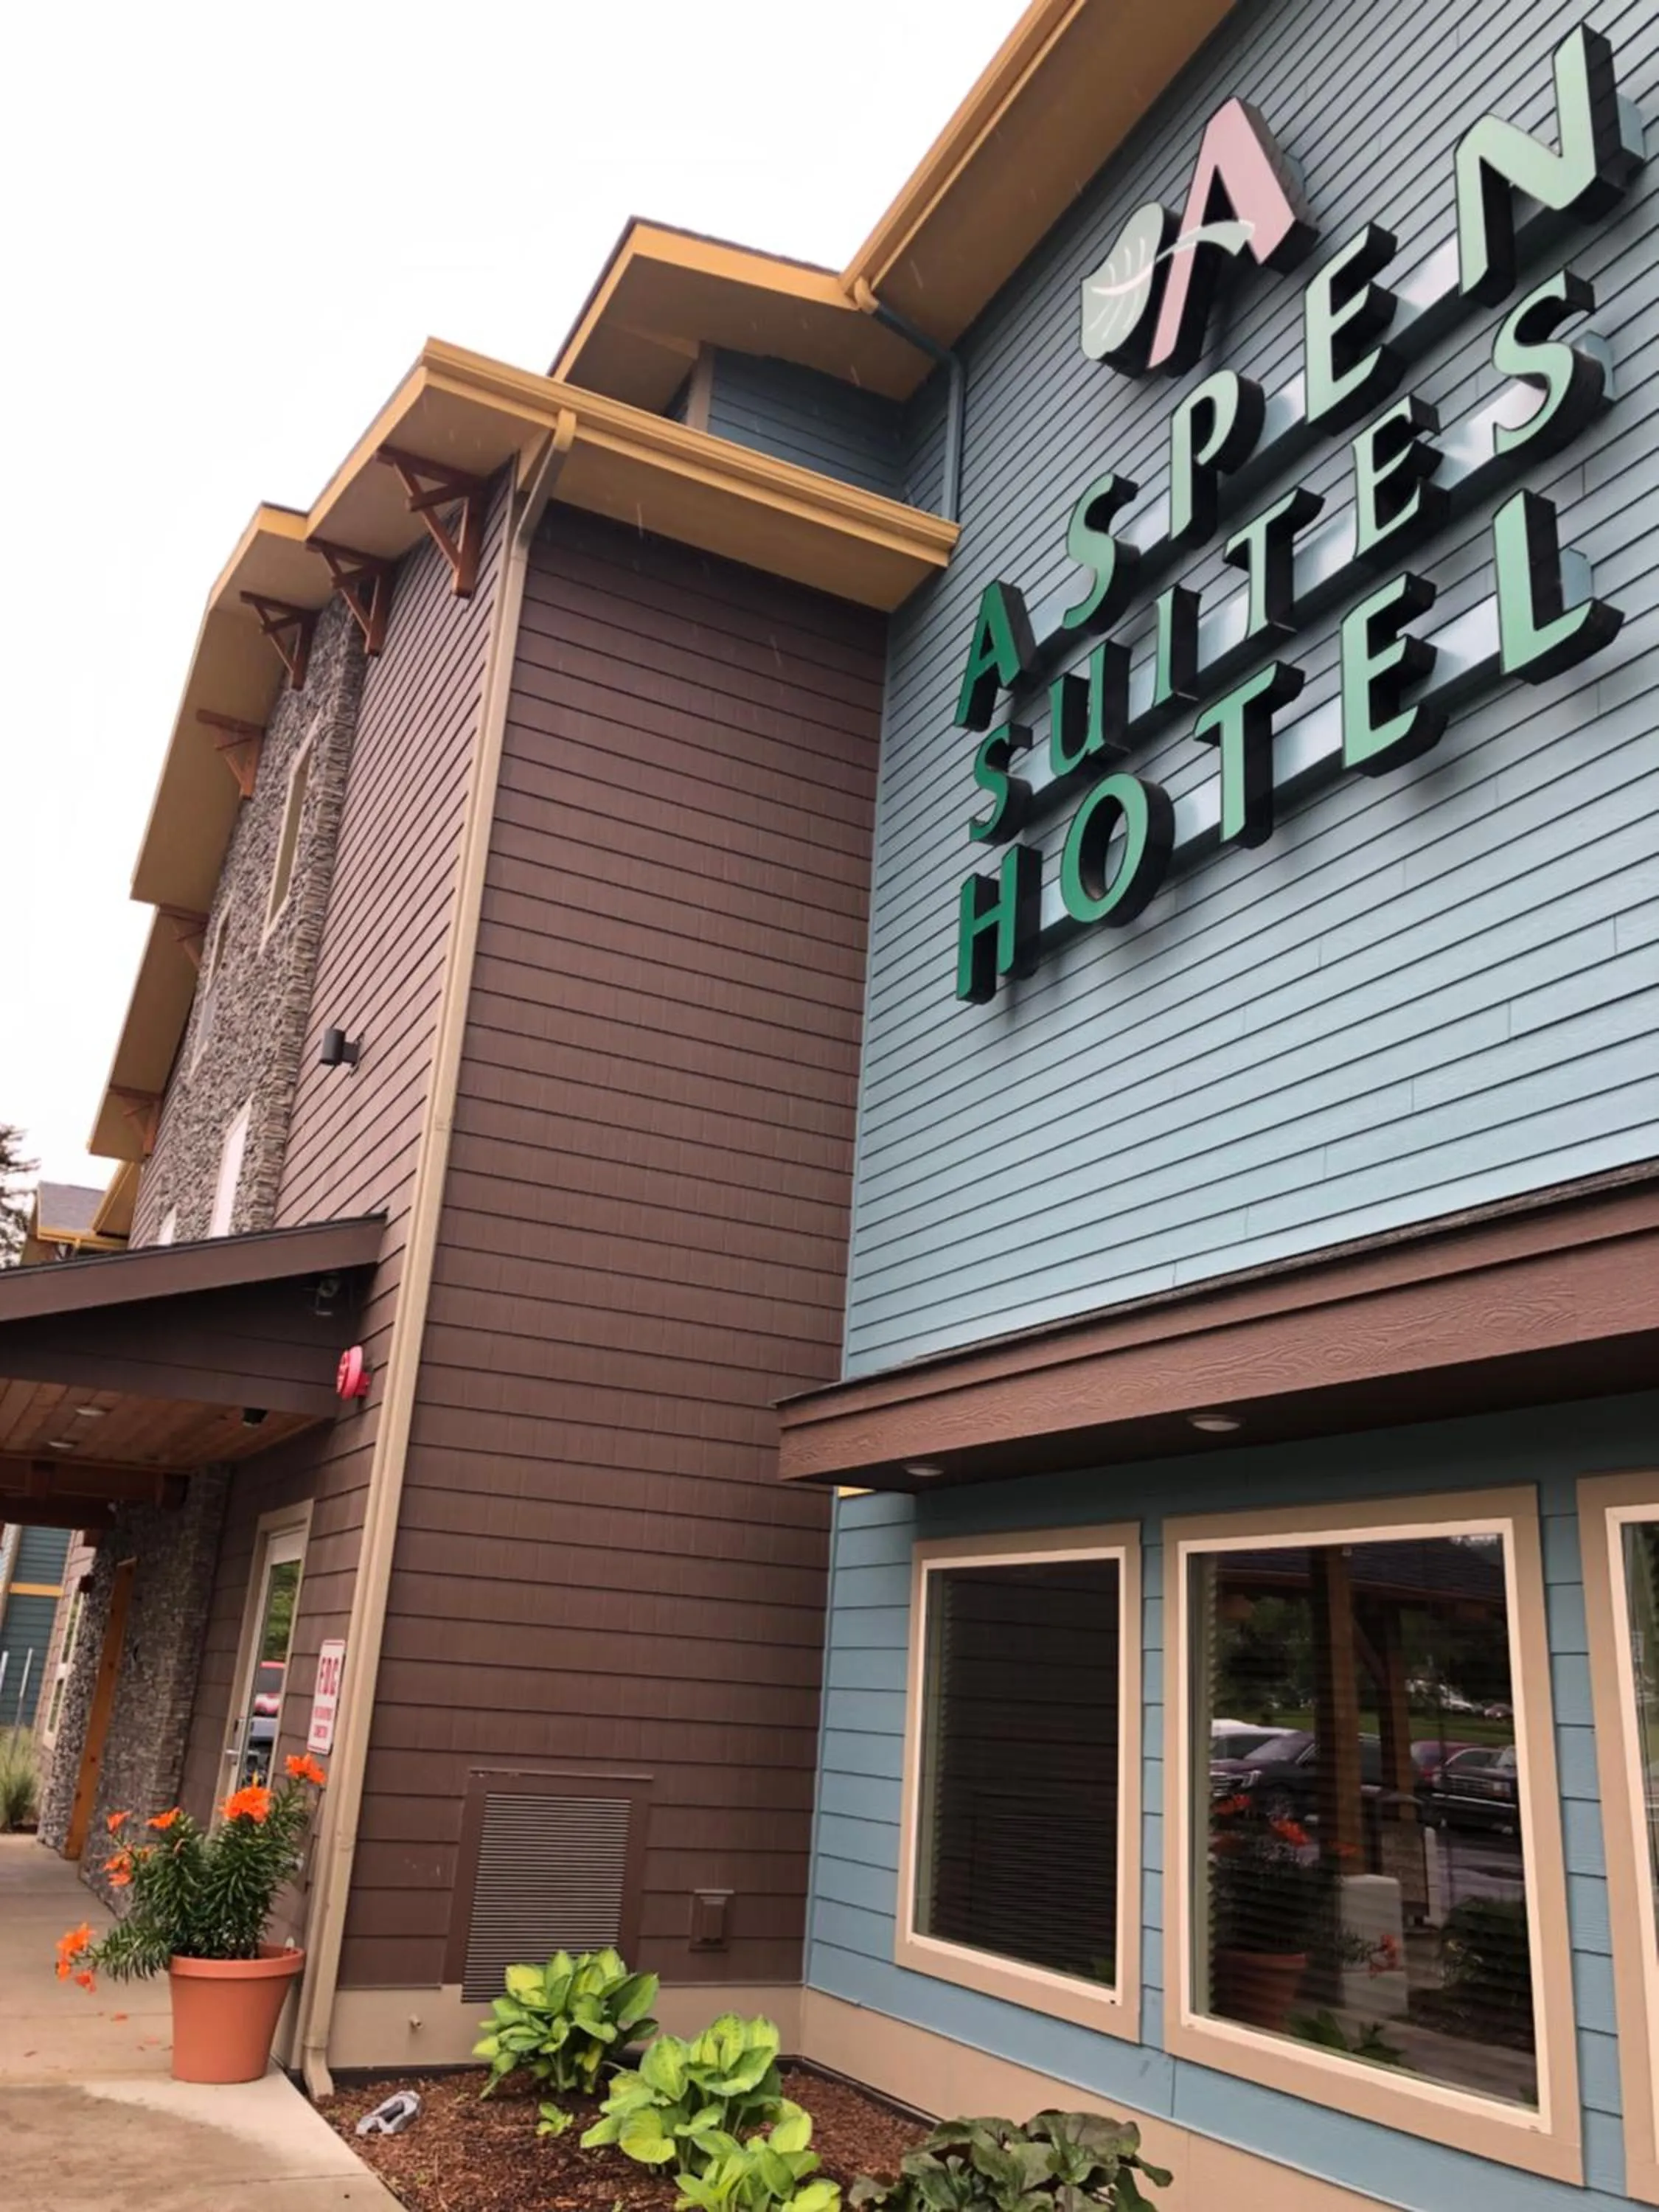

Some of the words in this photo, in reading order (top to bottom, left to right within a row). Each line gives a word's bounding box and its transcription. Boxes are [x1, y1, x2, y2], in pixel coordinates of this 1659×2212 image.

[955, 22, 1601, 731] ASPEN
[970, 268, 1596, 844] SUITES
[956, 488, 1597, 1003] HOTEL
